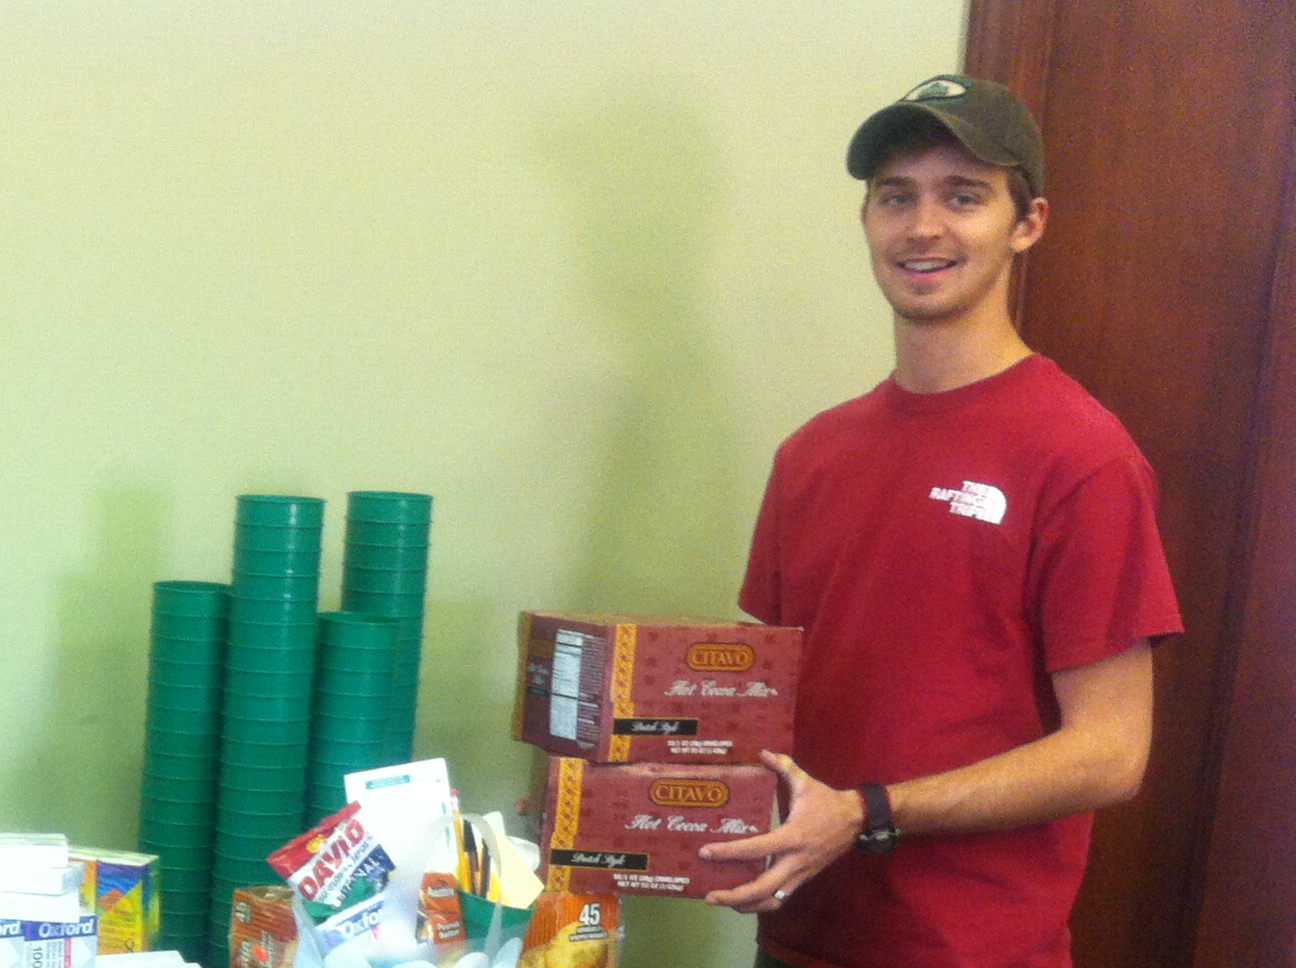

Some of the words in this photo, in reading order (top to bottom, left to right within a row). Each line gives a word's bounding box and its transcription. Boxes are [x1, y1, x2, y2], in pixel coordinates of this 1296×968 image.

[692, 649, 749, 666] CITAVO
[655, 784, 722, 802] CITAVO
[625, 814, 662, 831] Hot
[667, 815, 708, 833] Cocoa
[710, 817, 759, 834] Mix
[298, 818, 365, 902] DAVID
[579, 903, 601, 926] 45
[39, 918, 94, 939] Oxford
[32, 946, 44, 968] 100
